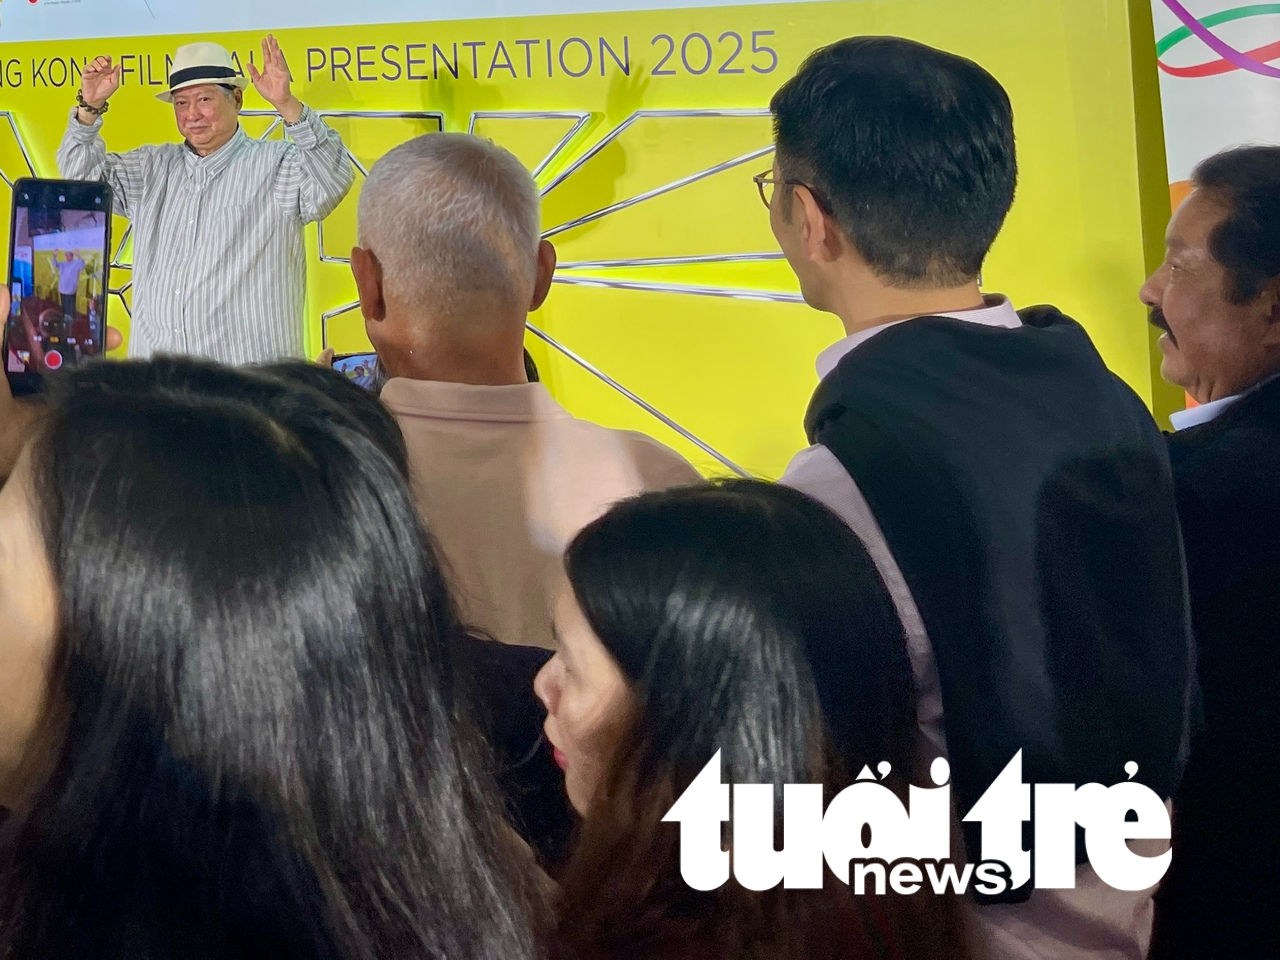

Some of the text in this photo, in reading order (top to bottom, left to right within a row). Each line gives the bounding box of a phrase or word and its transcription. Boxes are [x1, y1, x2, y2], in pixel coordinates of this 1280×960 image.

[31, 55, 82, 87] KON
[307, 36, 630, 82] PRESENTATION
[650, 30, 778, 76] 2025
